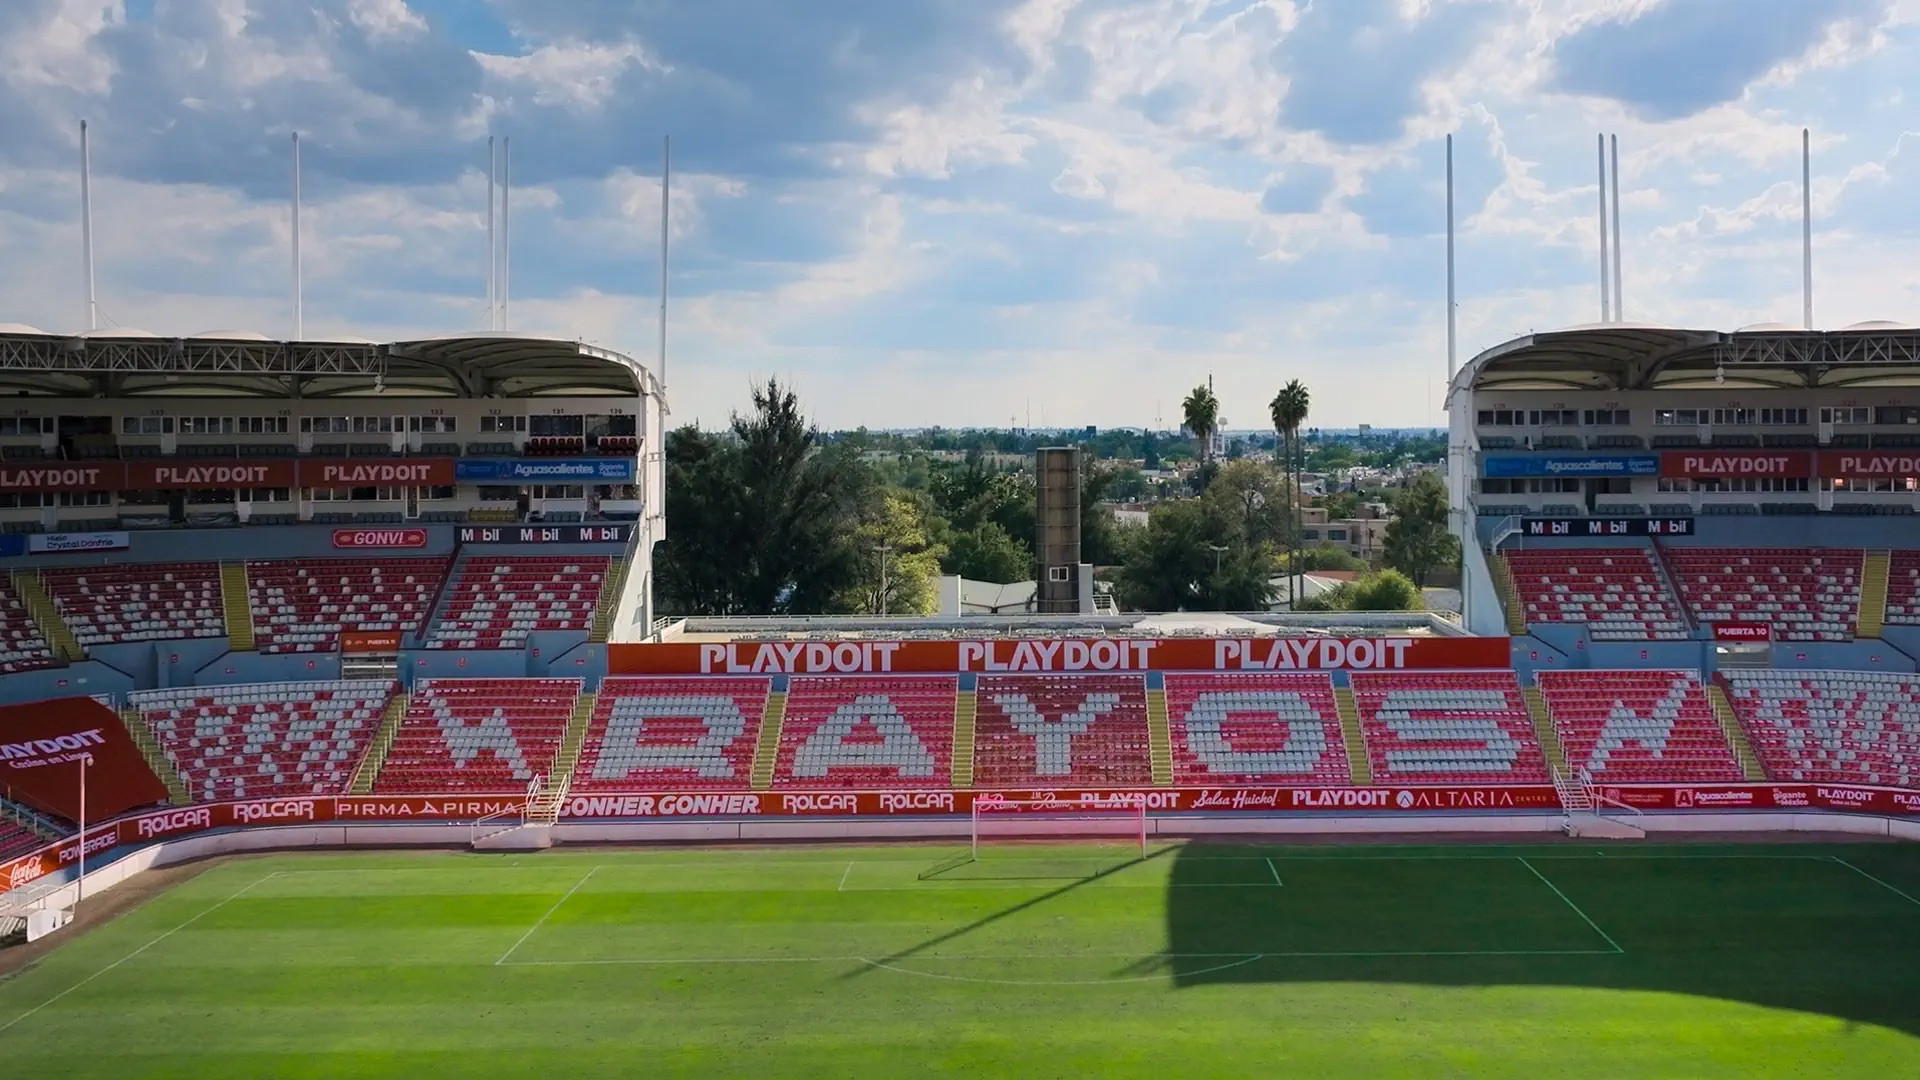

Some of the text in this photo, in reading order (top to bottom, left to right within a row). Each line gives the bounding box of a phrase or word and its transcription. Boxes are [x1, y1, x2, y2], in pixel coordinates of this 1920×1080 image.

[514, 463, 594, 477] Aguascalientes
[1545, 460, 1624, 473] Aguascalientes
[1684, 457, 1789, 473] PLAYDOIT
[155, 466, 268, 484] PLAYDOIT
[324, 465, 430, 482] PLAYDOIT
[47, 541, 80, 549] Crystal
[354, 532, 404, 544] GONVI
[1718, 627, 1767, 636] PUERTA 10
[701, 643, 900, 673] PLAYDOIT
[959, 641, 1156, 671] PLAYDOIT
[1215, 640, 1413, 669] PLAYDOIT
[1081, 792, 1181, 809] PLAYDOIT
[1190, 789, 1278, 809] Salsa Huichol
[1292, 790, 1390, 806] PLAYDOIT
[1416, 791, 1513, 807] ALTARIA
[1695, 791, 1753, 801] Aguascalientes
[1773, 791, 1806, 800] gigante
[1817, 788, 1874, 801] PLAYDOIT
[338, 802, 518, 815] PIRMA PIRMA
[558, 795, 759, 816] GONHER GONHER
[783, 793, 954, 814] ROLCAR ROLCAR
[138, 801, 314, 838] ROLCAR ROLCAR
[59, 832, 116, 863] POWERADE
